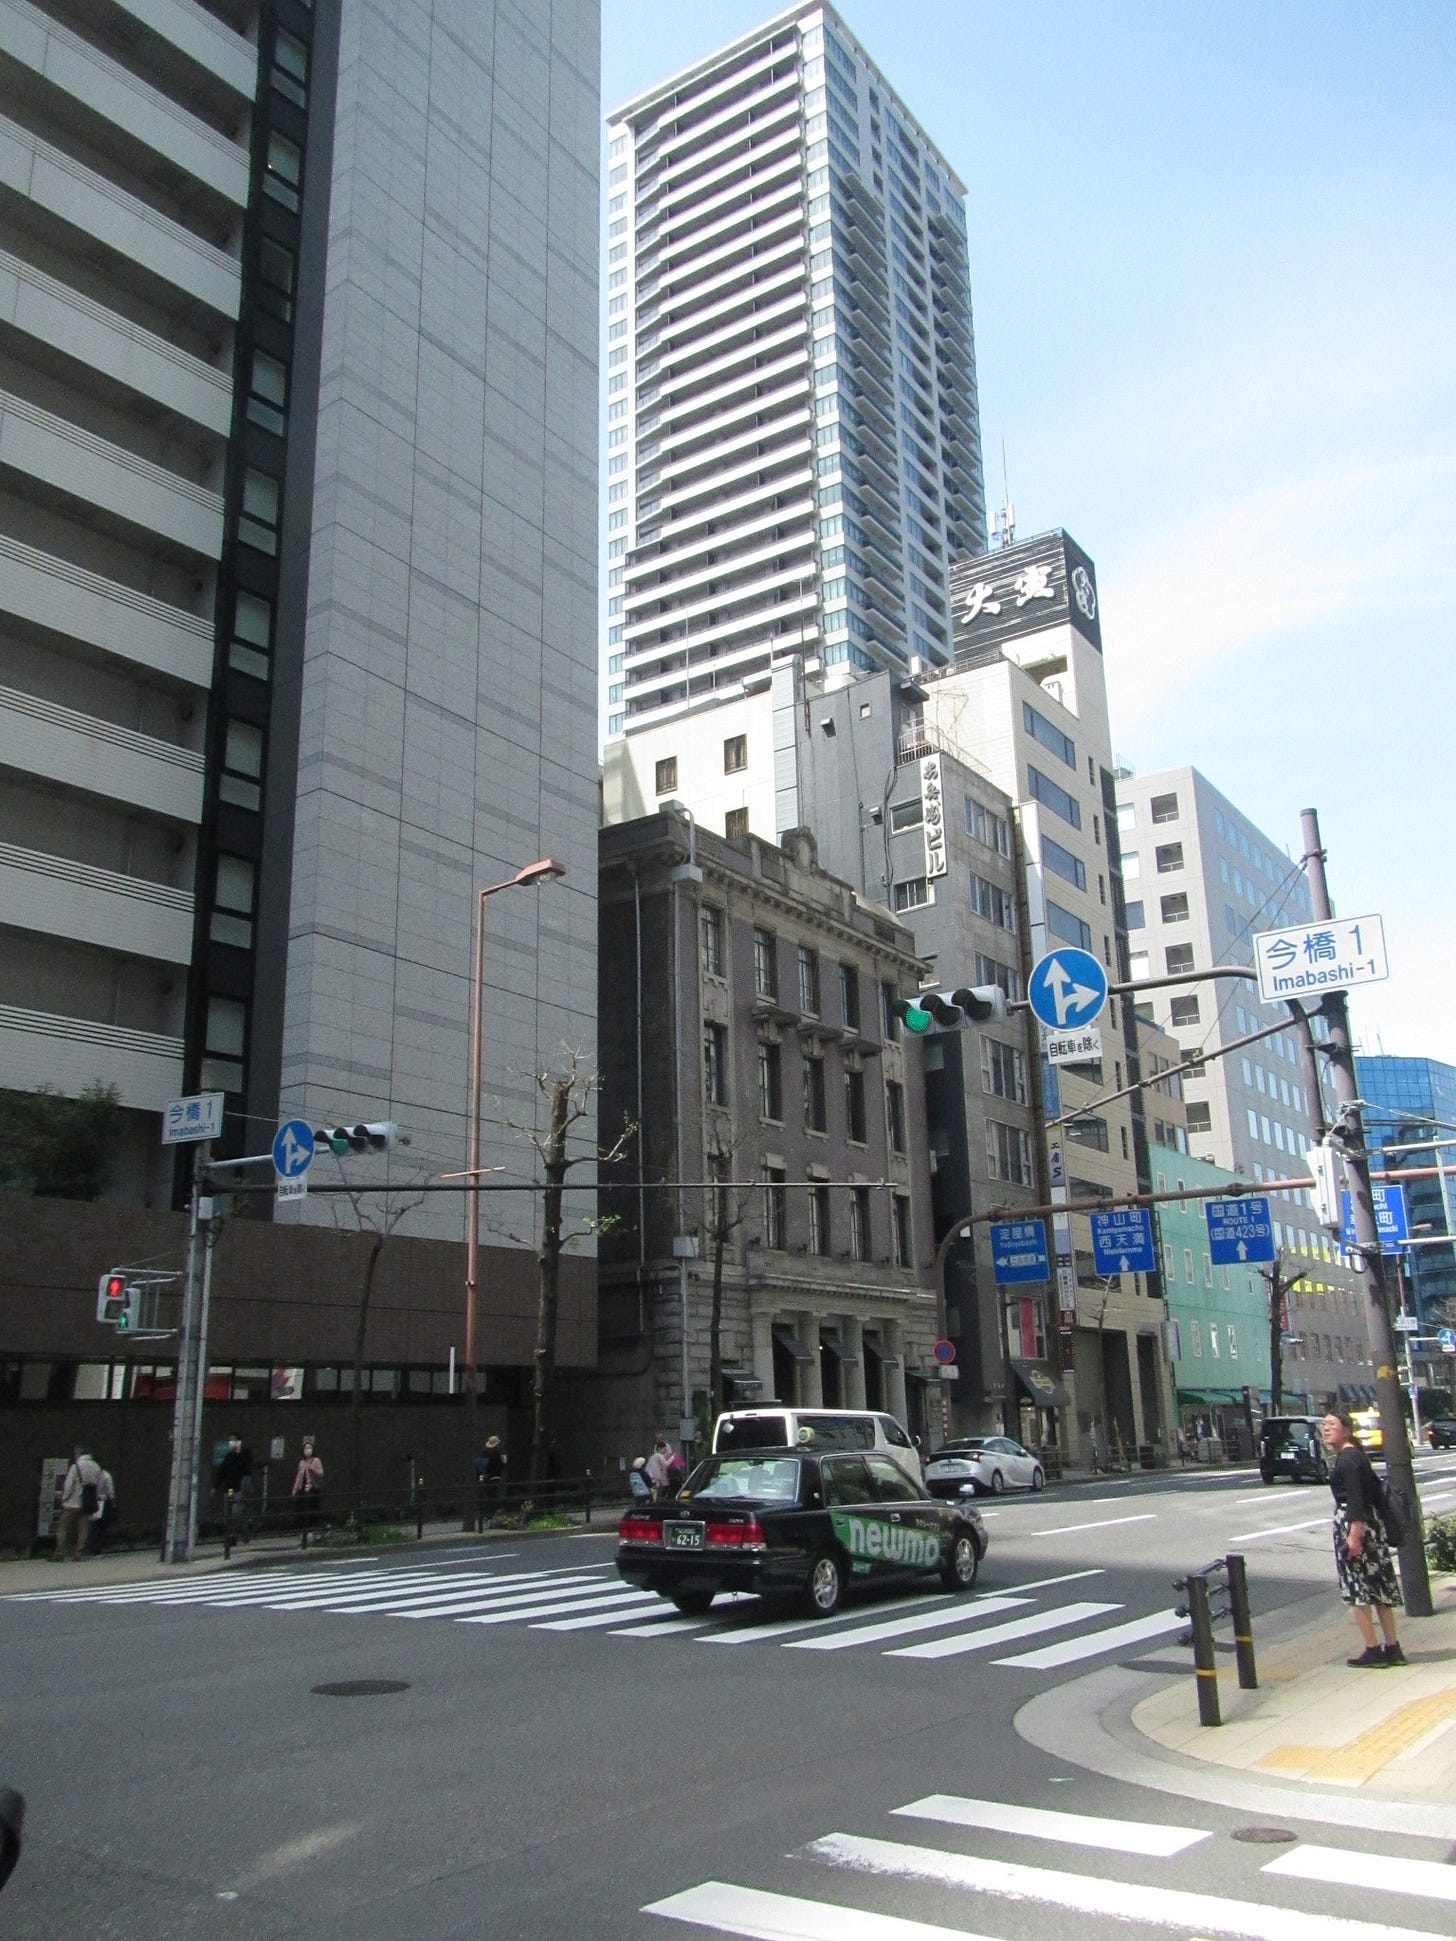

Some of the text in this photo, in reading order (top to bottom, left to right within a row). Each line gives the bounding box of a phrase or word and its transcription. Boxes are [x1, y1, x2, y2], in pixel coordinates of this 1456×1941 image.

[1266, 924, 1363, 971] 今橋1
[1273, 959, 1376, 991] Imabashi-1
[1049, 1037, 1100, 1057] 自転車を除く
[1211, 1201, 1263, 1217] 国道1号
[1097, 1211, 1141, 1227] 神山町
[1223, 1216, 1249, 1225] ROUTE
[1099, 1232, 1145, 1248] 西天満
[1210, 1224, 1270, 1240] (国道423号)
[676, 1534, 700, 1546] 62-15
[849, 1519, 940, 1566] newmo
